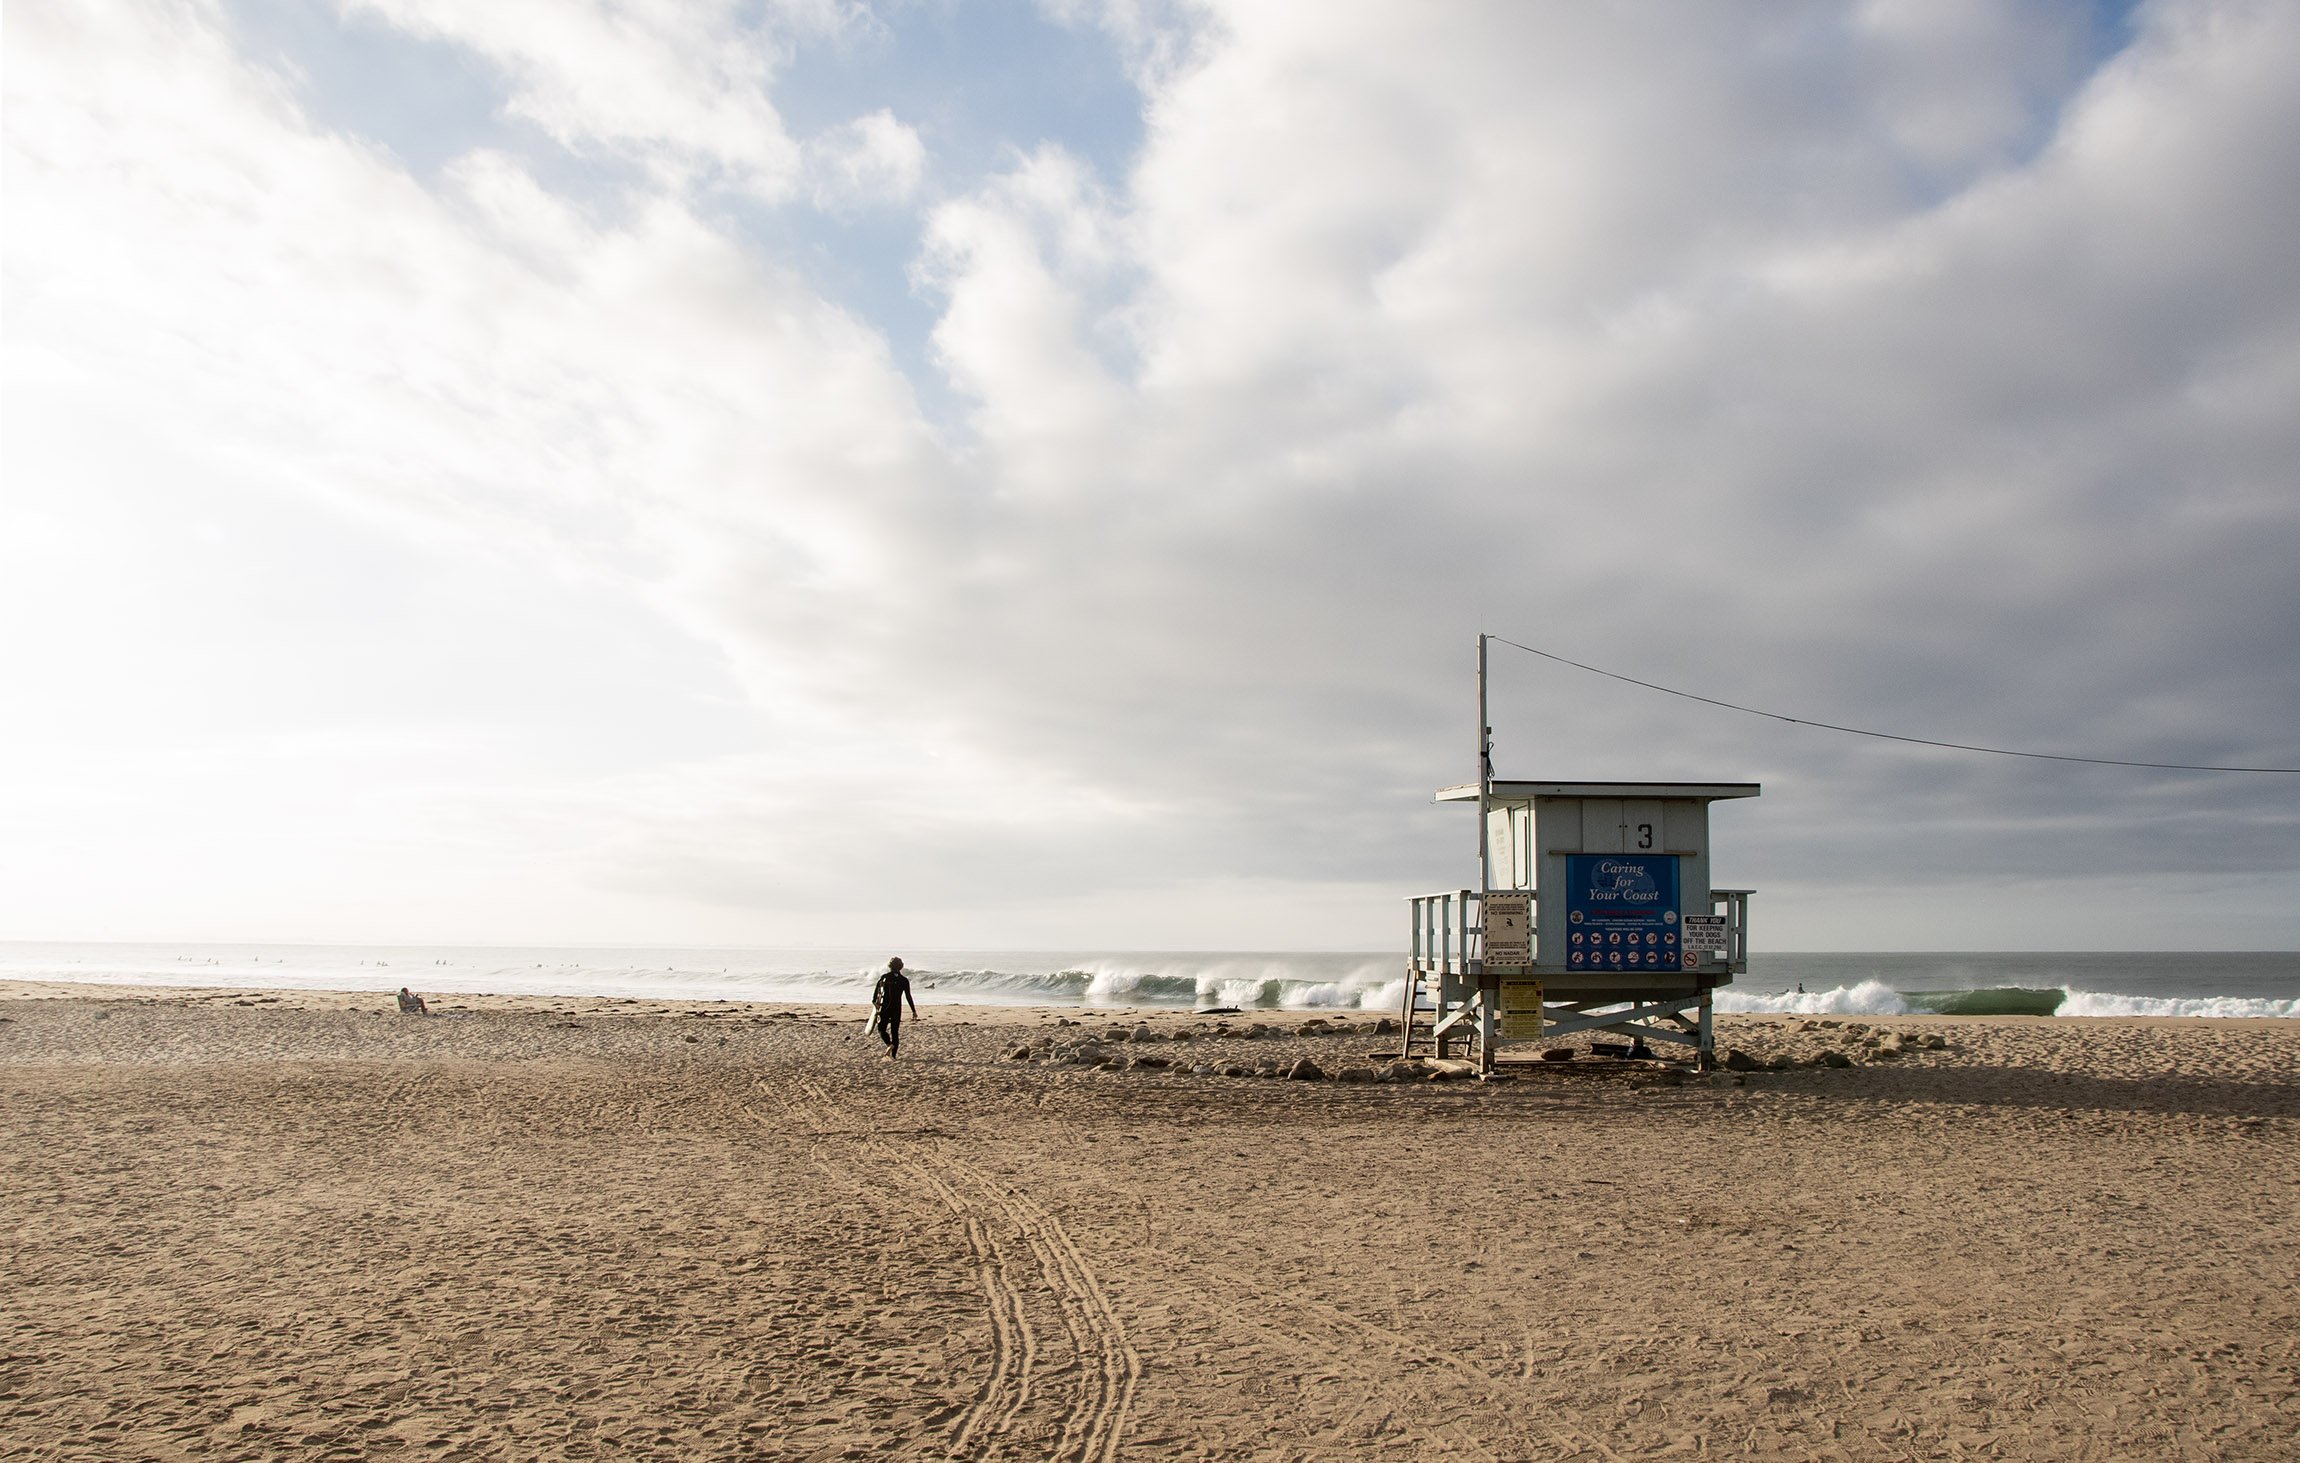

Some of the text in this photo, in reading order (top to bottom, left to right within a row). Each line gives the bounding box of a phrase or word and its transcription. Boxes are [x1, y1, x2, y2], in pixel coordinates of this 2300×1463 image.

[1638, 824, 1652, 848] 3
[1601, 862, 1644, 877] Caring
[1612, 876, 1634, 889] for
[1589, 889, 1659, 900] Your Coast
